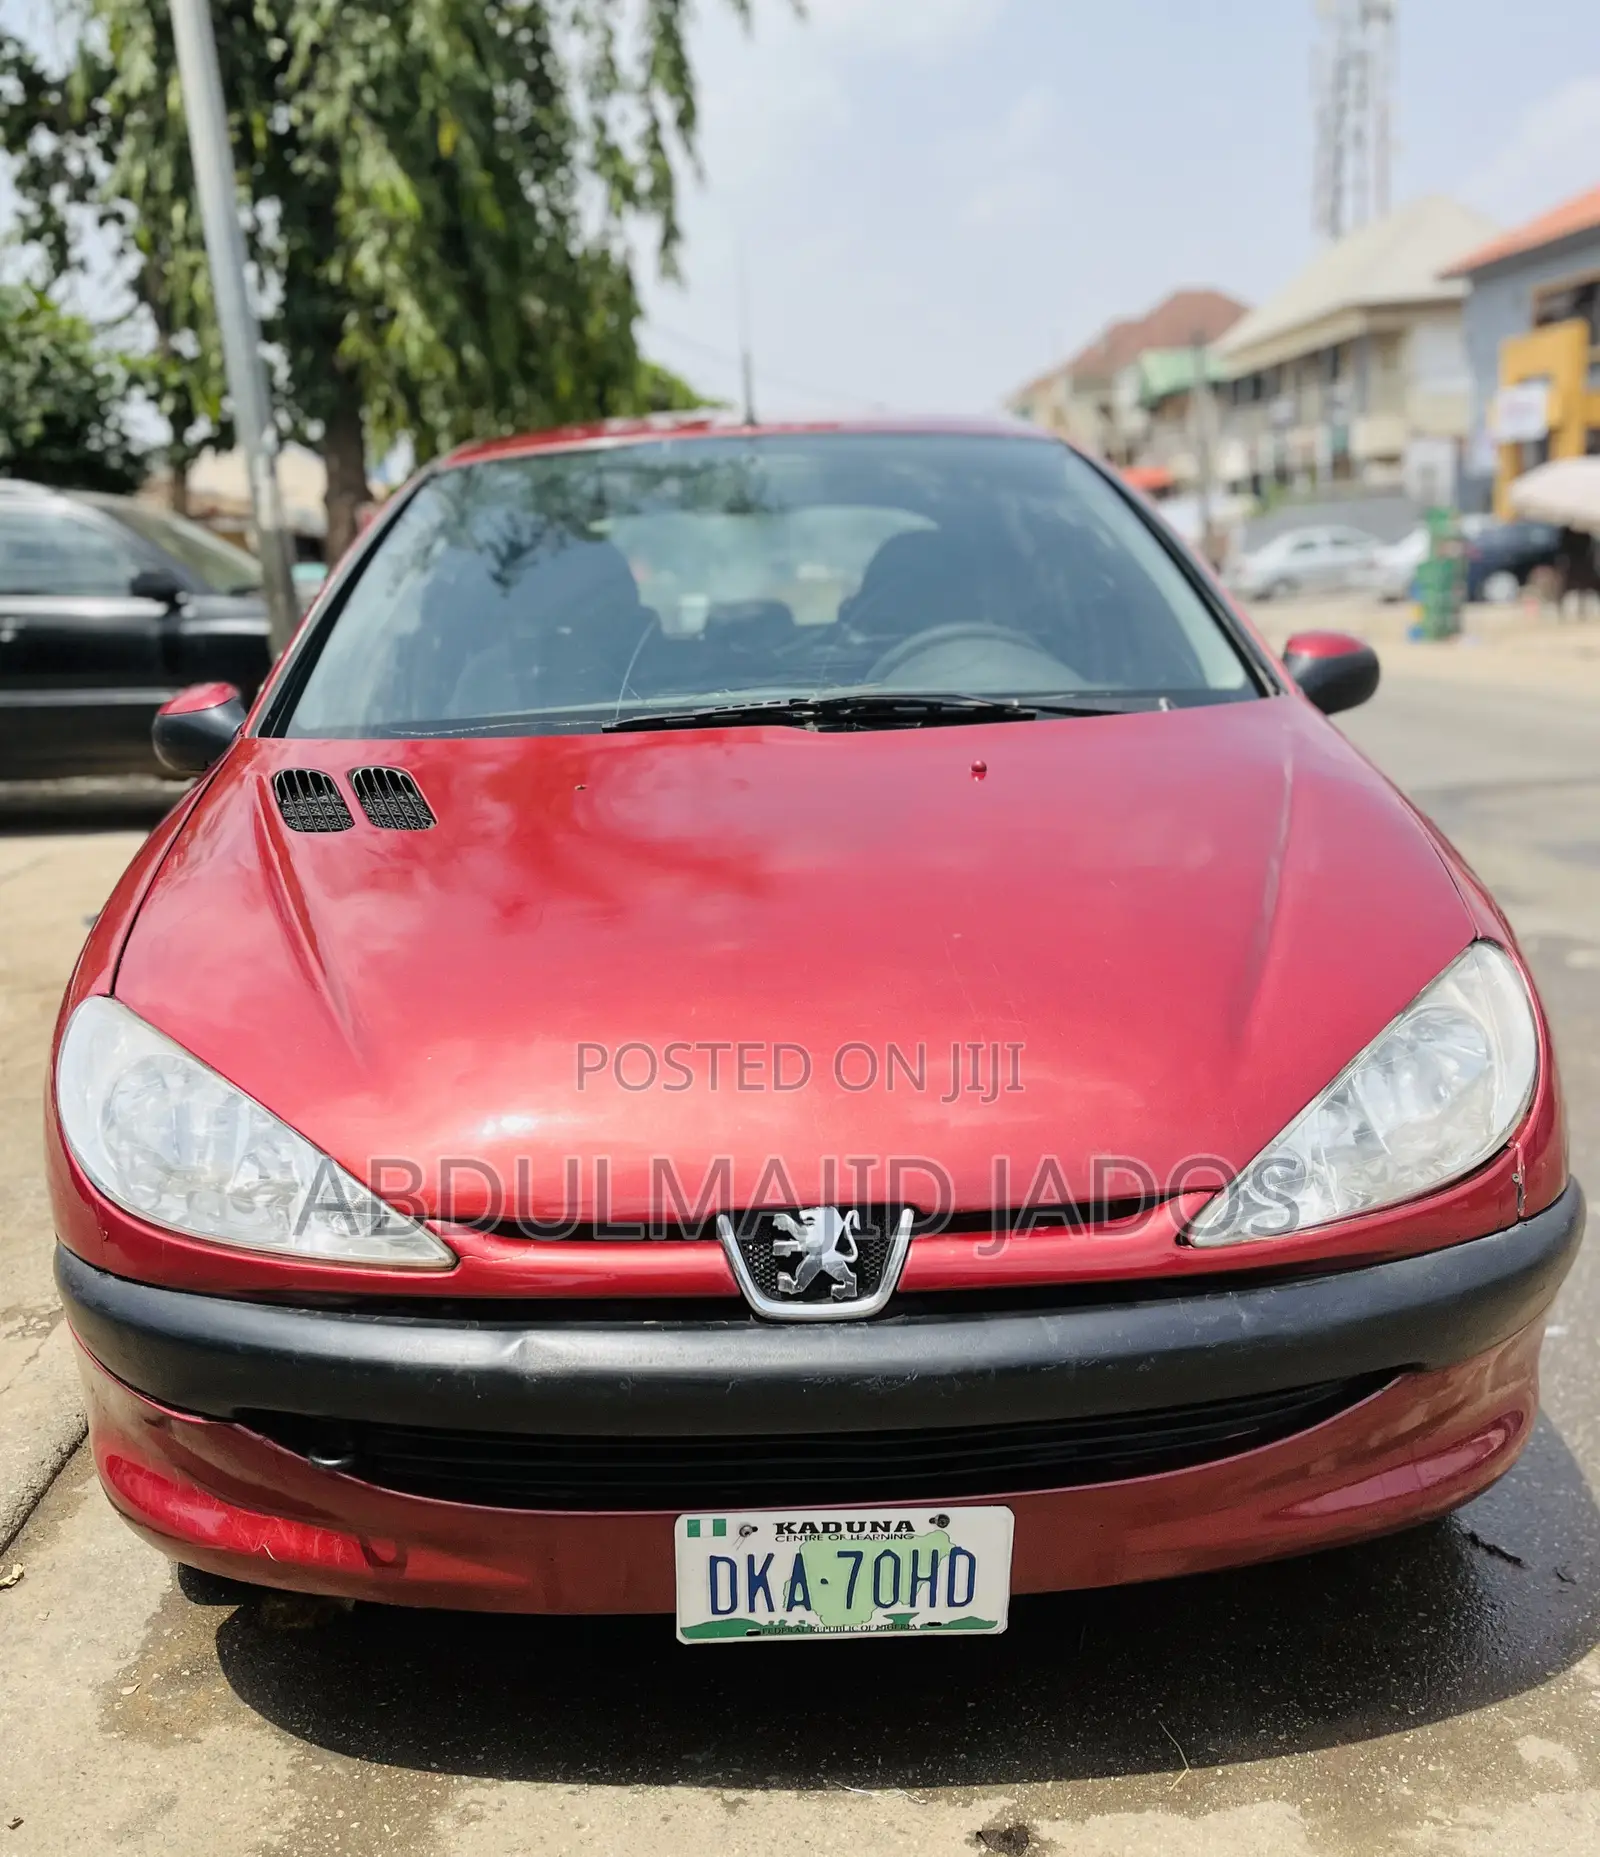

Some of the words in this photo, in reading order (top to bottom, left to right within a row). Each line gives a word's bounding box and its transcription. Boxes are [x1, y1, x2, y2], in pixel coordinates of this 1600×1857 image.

[773, 1520, 916, 1535] KADUNA
[775, 1534, 824, 1542] CENTRE
[828, 1533, 847, 1541] OF
[850, 1533, 915, 1541] LEARNING
[810, 1624, 860, 1633] REPUBLIC
